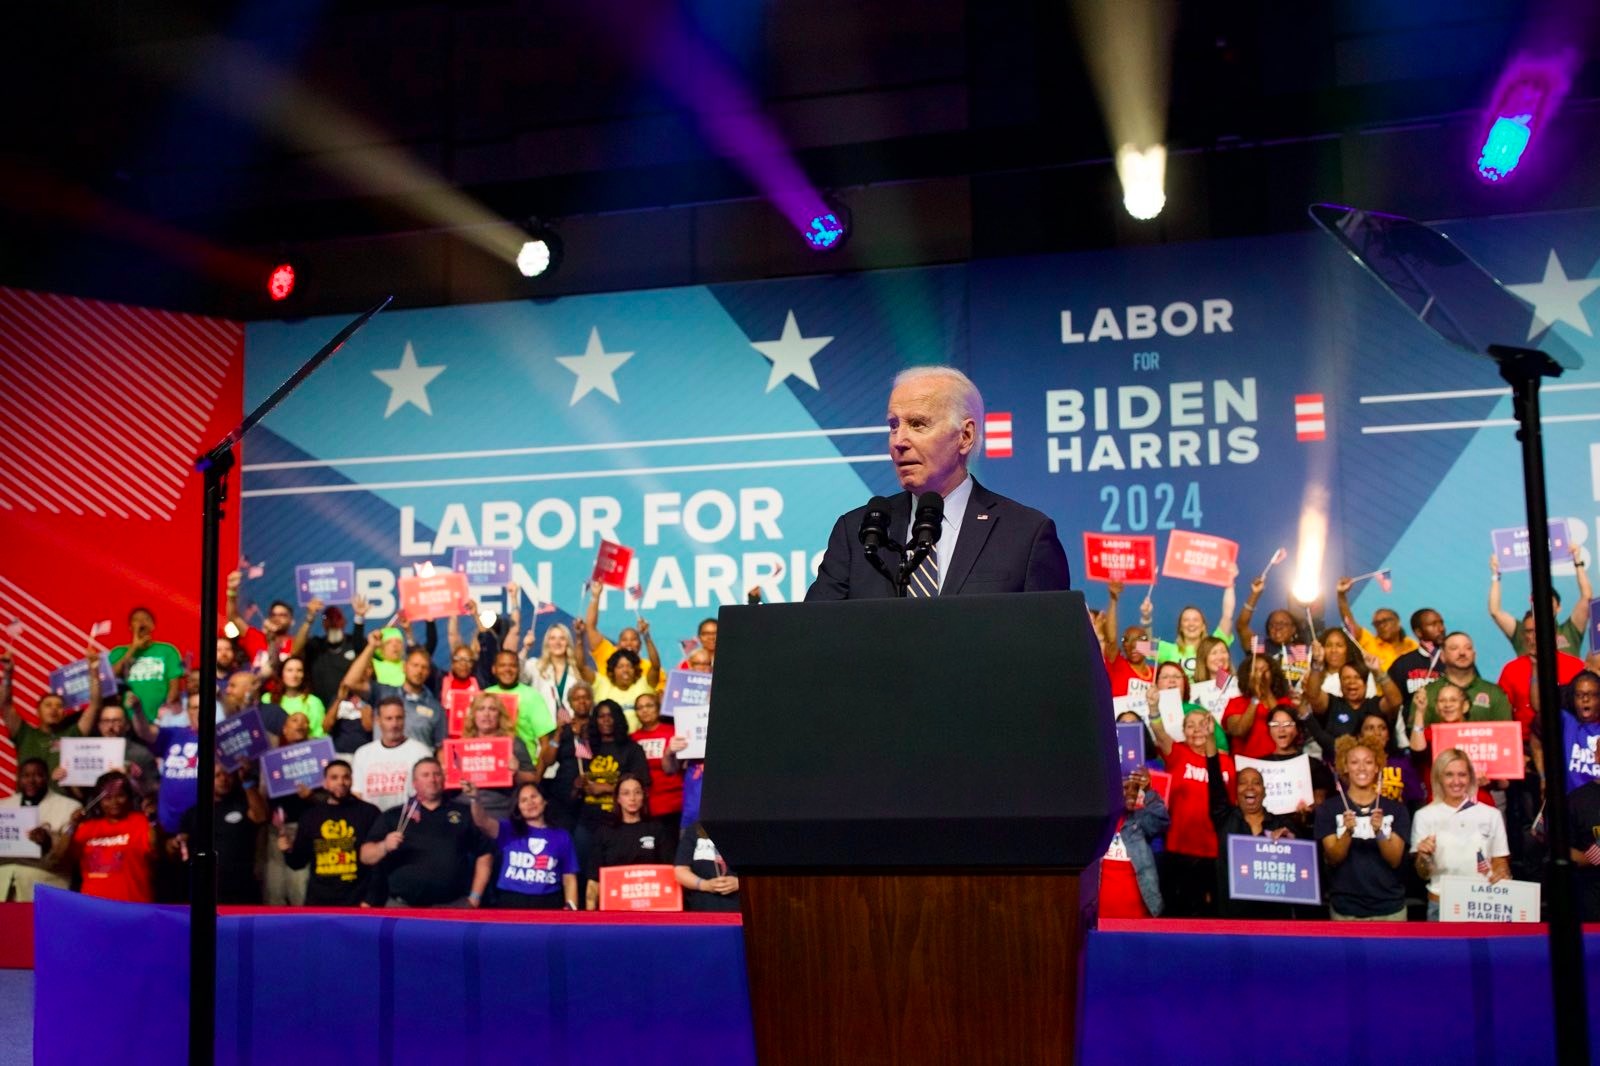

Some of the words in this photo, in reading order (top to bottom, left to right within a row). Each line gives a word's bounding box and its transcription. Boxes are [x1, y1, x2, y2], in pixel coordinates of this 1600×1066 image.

[1061, 299, 1233, 343] LABOR
[1133, 352, 1160, 371] FOR
[1046, 377, 1258, 433] BIDEN
[1047, 426, 1260, 473] HARRIS
[1100, 482, 1203, 532] 2024
[400, 496, 622, 556] LABOR
[643, 487, 784, 545] FOR
[1102, 541, 1131, 549] LABOR
[592, 549, 829, 611] HARRI
[1458, 728, 1493, 737] LABOR
[1260, 767, 1286, 775] ABOR
[1255, 843, 1292, 855] LABOR
[509, 850, 558, 871] BIDEN
[624, 869, 657, 879] LABOR
[1253, 861, 1296, 874] BIDEN
[505, 865, 557, 885] HARRIS
[1253, 870, 1296, 882] HARRIS
[620, 883, 661, 893] BIDEN
[1264, 882, 1286, 895] 2024
[1470, 885, 1509, 895] LABOR
[1467, 901, 1514, 914] BIDEN
[1467, 911, 1513, 923] HARRIS
